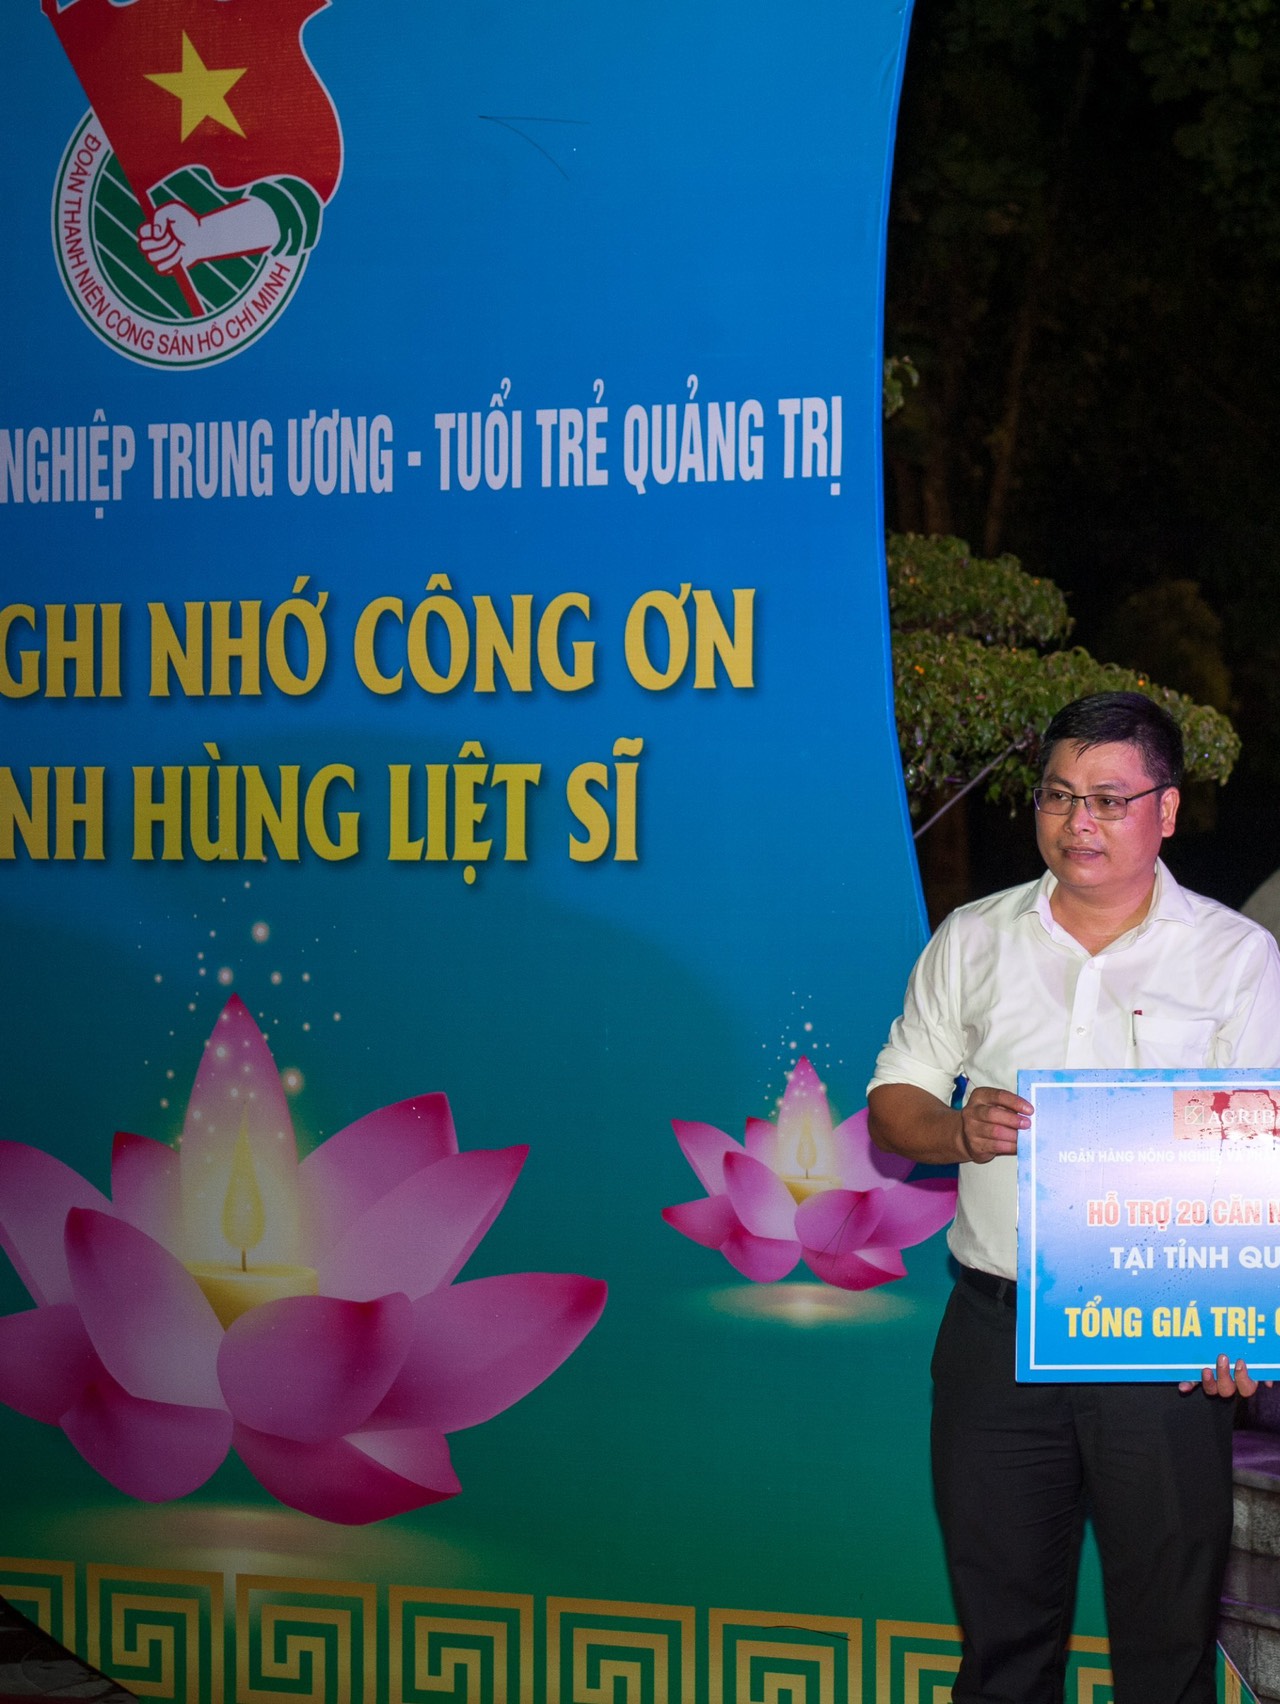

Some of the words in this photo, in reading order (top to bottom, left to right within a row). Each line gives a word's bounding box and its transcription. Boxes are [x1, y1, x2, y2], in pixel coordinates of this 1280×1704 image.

[66, 133, 102, 194] ĐOÀN
[63, 197, 88, 269] THANH
[75, 268, 111, 318] NIÊN
[253, 261, 291, 315] MINH
[105, 309, 155, 351] CỘNG
[157, 329, 194, 355] SẢN
[197, 321, 224, 352] HỒ
[225, 302, 258, 339] CHÍ
[0, 408, 135, 519] NGHIỆP
[148, 419, 273, 499] TRUNG
[288, 409, 393, 496] ƯƠNG
[435, 378, 522, 491] TUỔI
[536, 379, 609, 487] TRẺ
[624, 375, 765, 494] QUẢNG
[778, 396, 843, 495] TRỊ
[0, 603, 122, 698] GHI
[148, 575, 328, 697] NHỚ
[354, 573, 596, 695] CÔNG
[624, 582, 756, 691] ƠN
[132, 742, 360, 861] HÙNG
[388, 740, 541, 884] LIỆT
[567, 737, 644, 862] SĨ
[1087, 1191, 1120, 1226] HỖ
[1125, 1197, 1173, 1231] TRỢ
[1176, 1200, 1207, 1226] 20
[1212, 1194, 1262, 1226] CĂN
[1109, 1246, 1154, 1276] TẠI
[1163, 1238, 1229, 1269] TỈNH
[1064, 1295, 1142, 1338] TỔNG
[1152, 1300, 1202, 1338] GIÁ
[1210, 1306, 1266, 1344] TRỊ:
